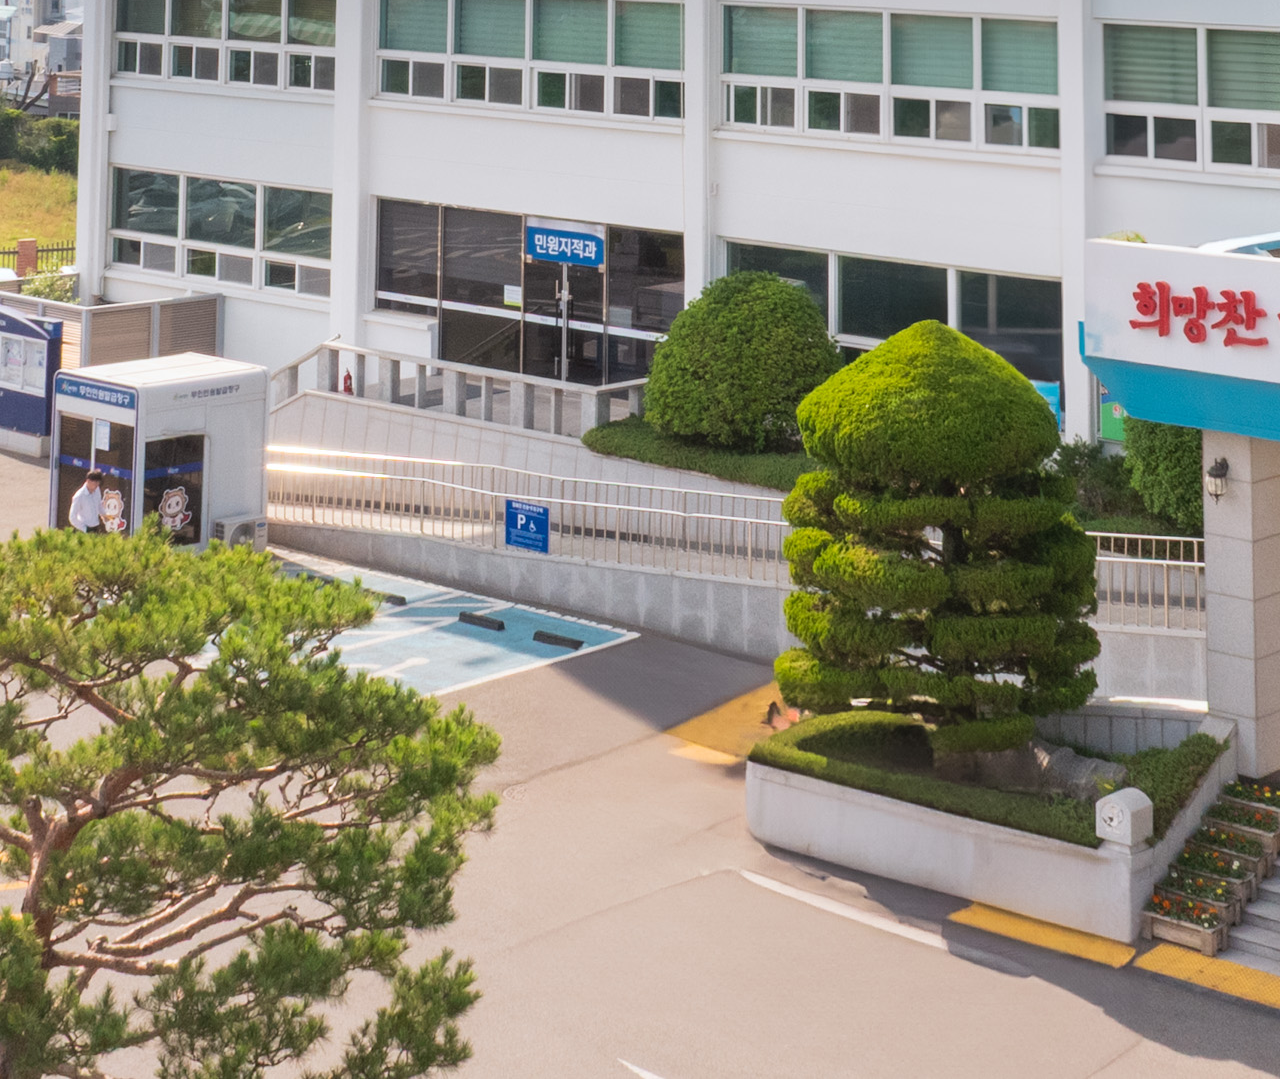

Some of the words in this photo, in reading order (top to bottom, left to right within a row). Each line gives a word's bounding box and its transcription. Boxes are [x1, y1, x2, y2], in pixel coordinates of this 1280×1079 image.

[534, 234, 597, 260] 민원지적과
[1129, 281, 1268, 347] 희망찬
[79, 385, 130, 405] 무인민원발급창구
[517, 514, 526, 529] P
